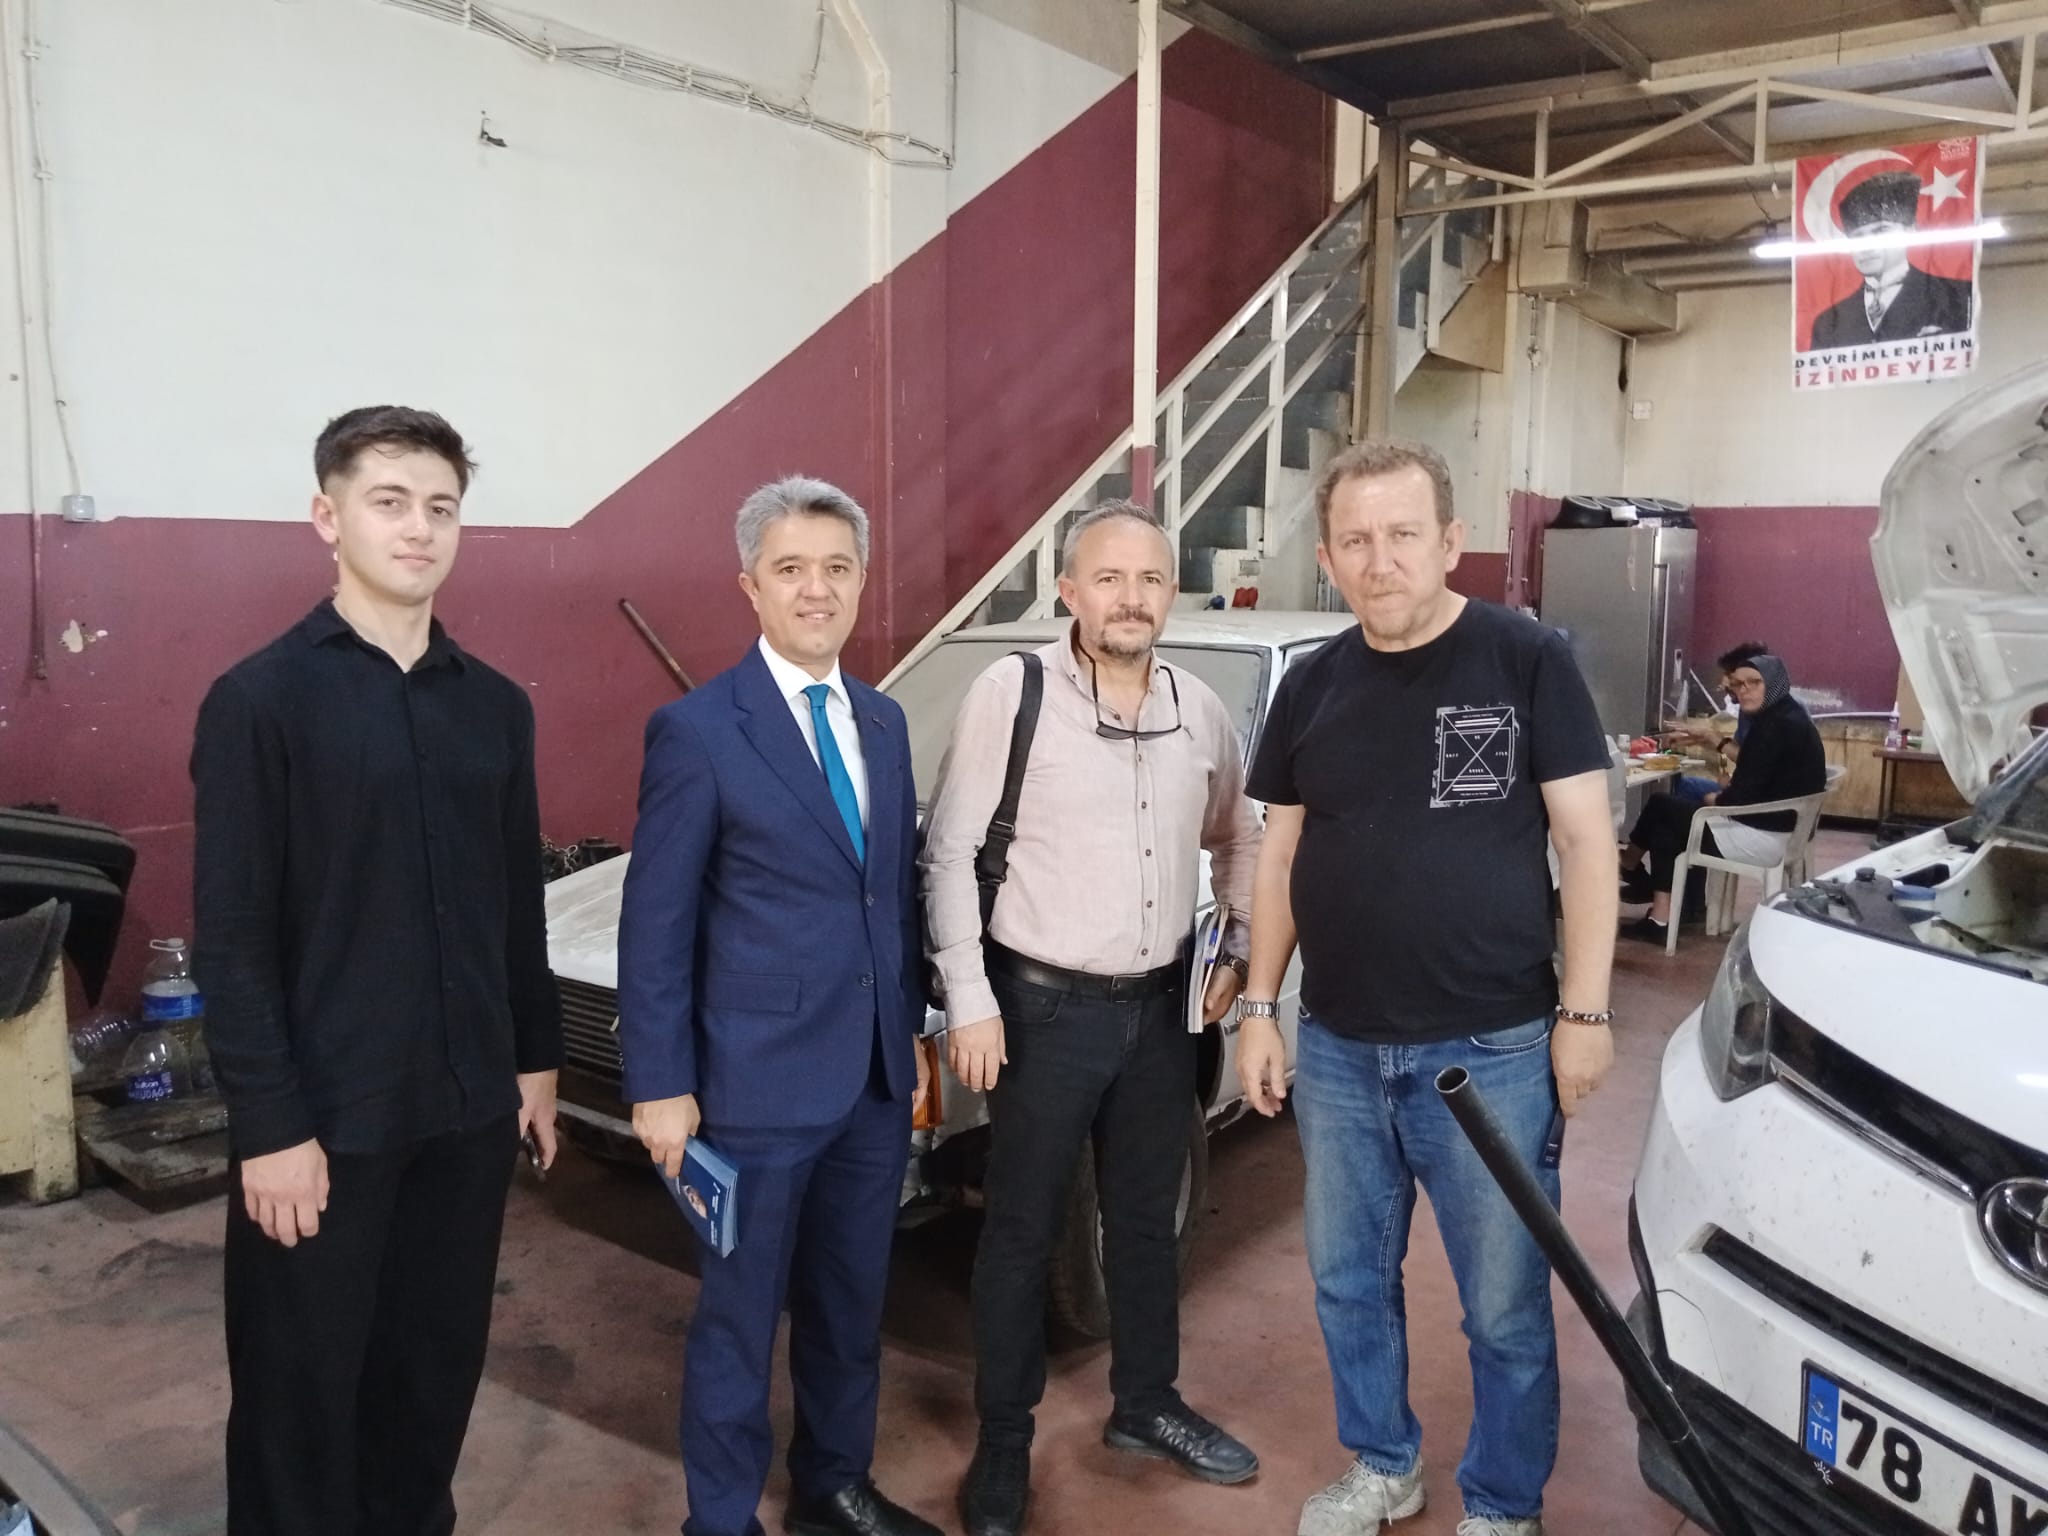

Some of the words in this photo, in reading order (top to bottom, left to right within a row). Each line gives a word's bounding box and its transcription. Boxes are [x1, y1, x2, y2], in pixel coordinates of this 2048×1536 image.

[1795, 338, 1972, 368] DEVRİMLERİNİN
[1795, 351, 1972, 387] İZİNDEYİZ!
[1811, 1421, 1834, 1450] TR
[1841, 1399, 1923, 1503] 78
